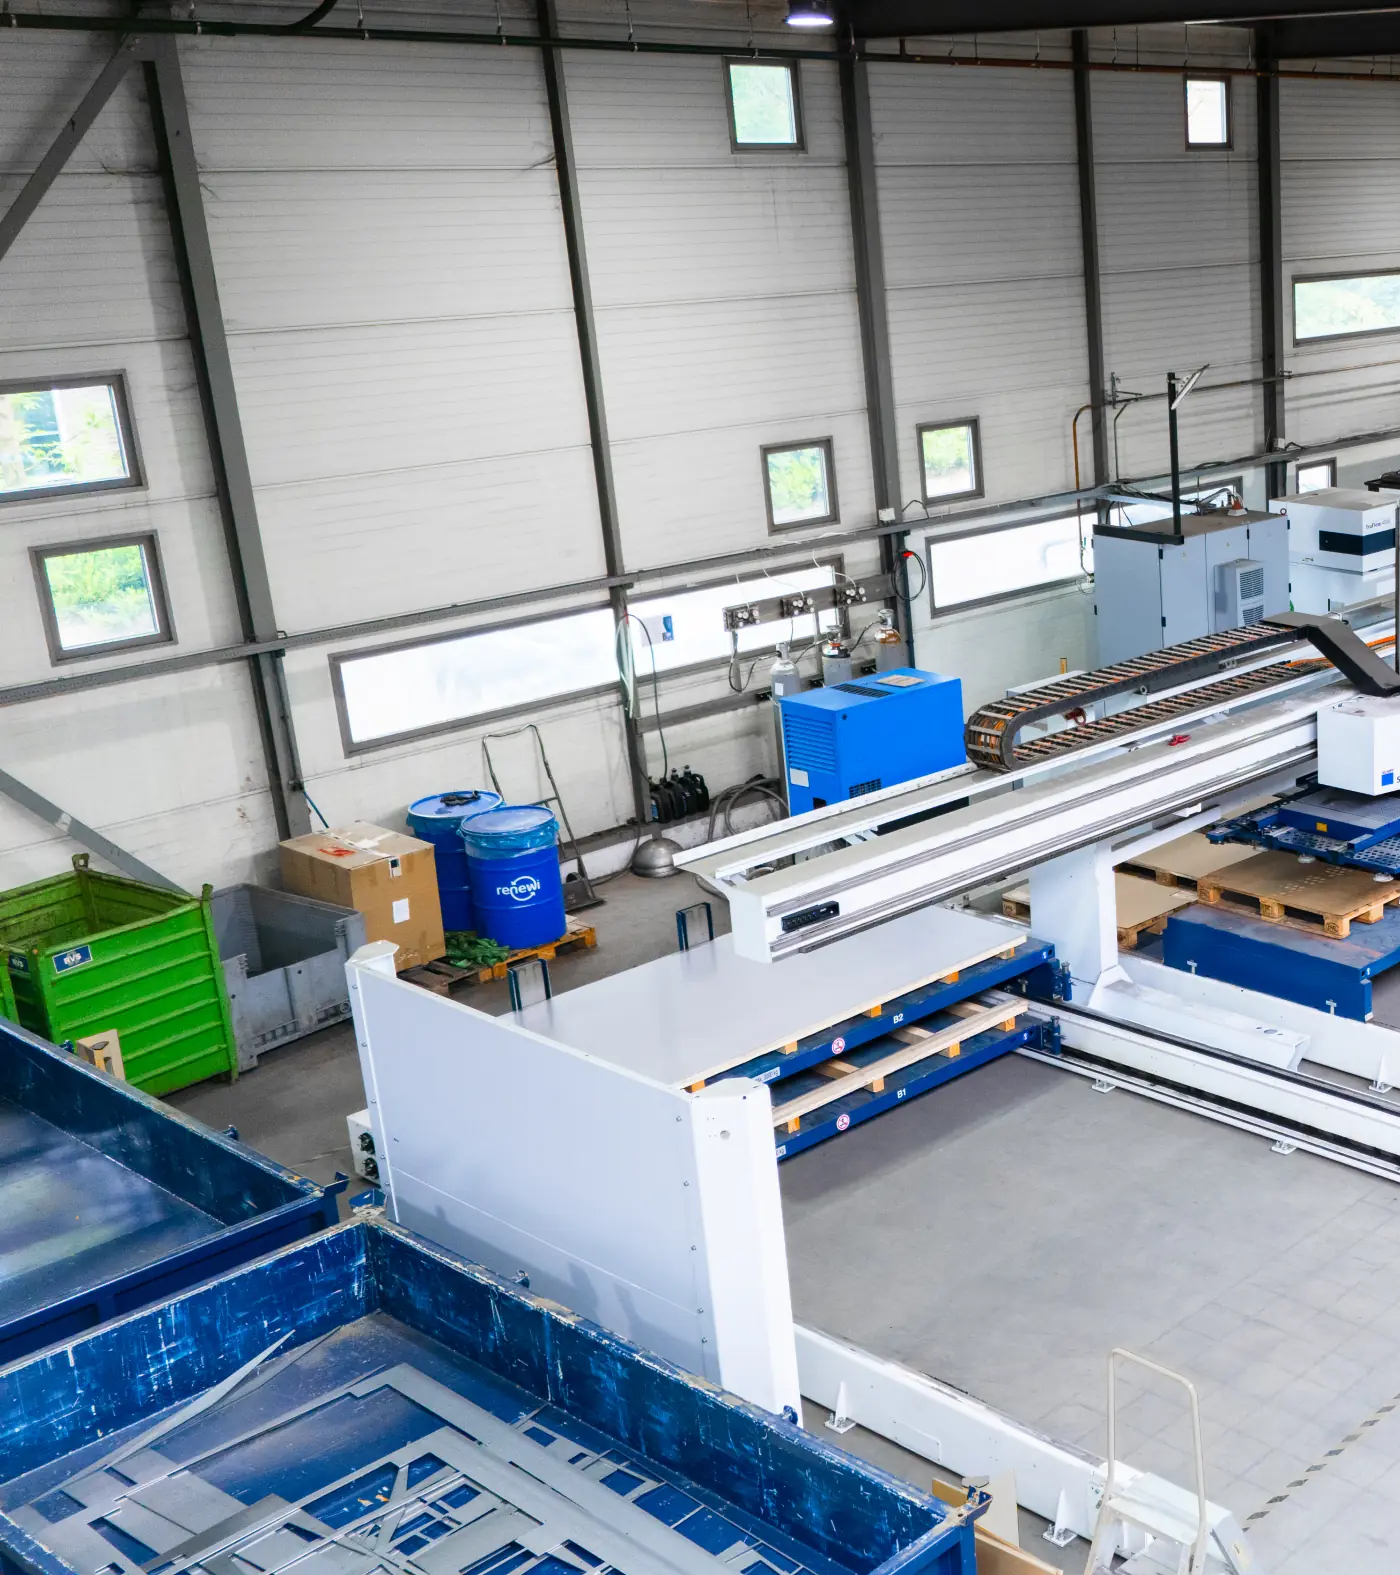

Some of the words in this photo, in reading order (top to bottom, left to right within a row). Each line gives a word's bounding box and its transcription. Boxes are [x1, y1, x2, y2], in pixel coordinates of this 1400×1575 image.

[496, 879, 541, 896] renewi
[63, 953, 82, 965] RVS
[893, 1013, 904, 1024] B2
[897, 1088, 906, 1099] B1
